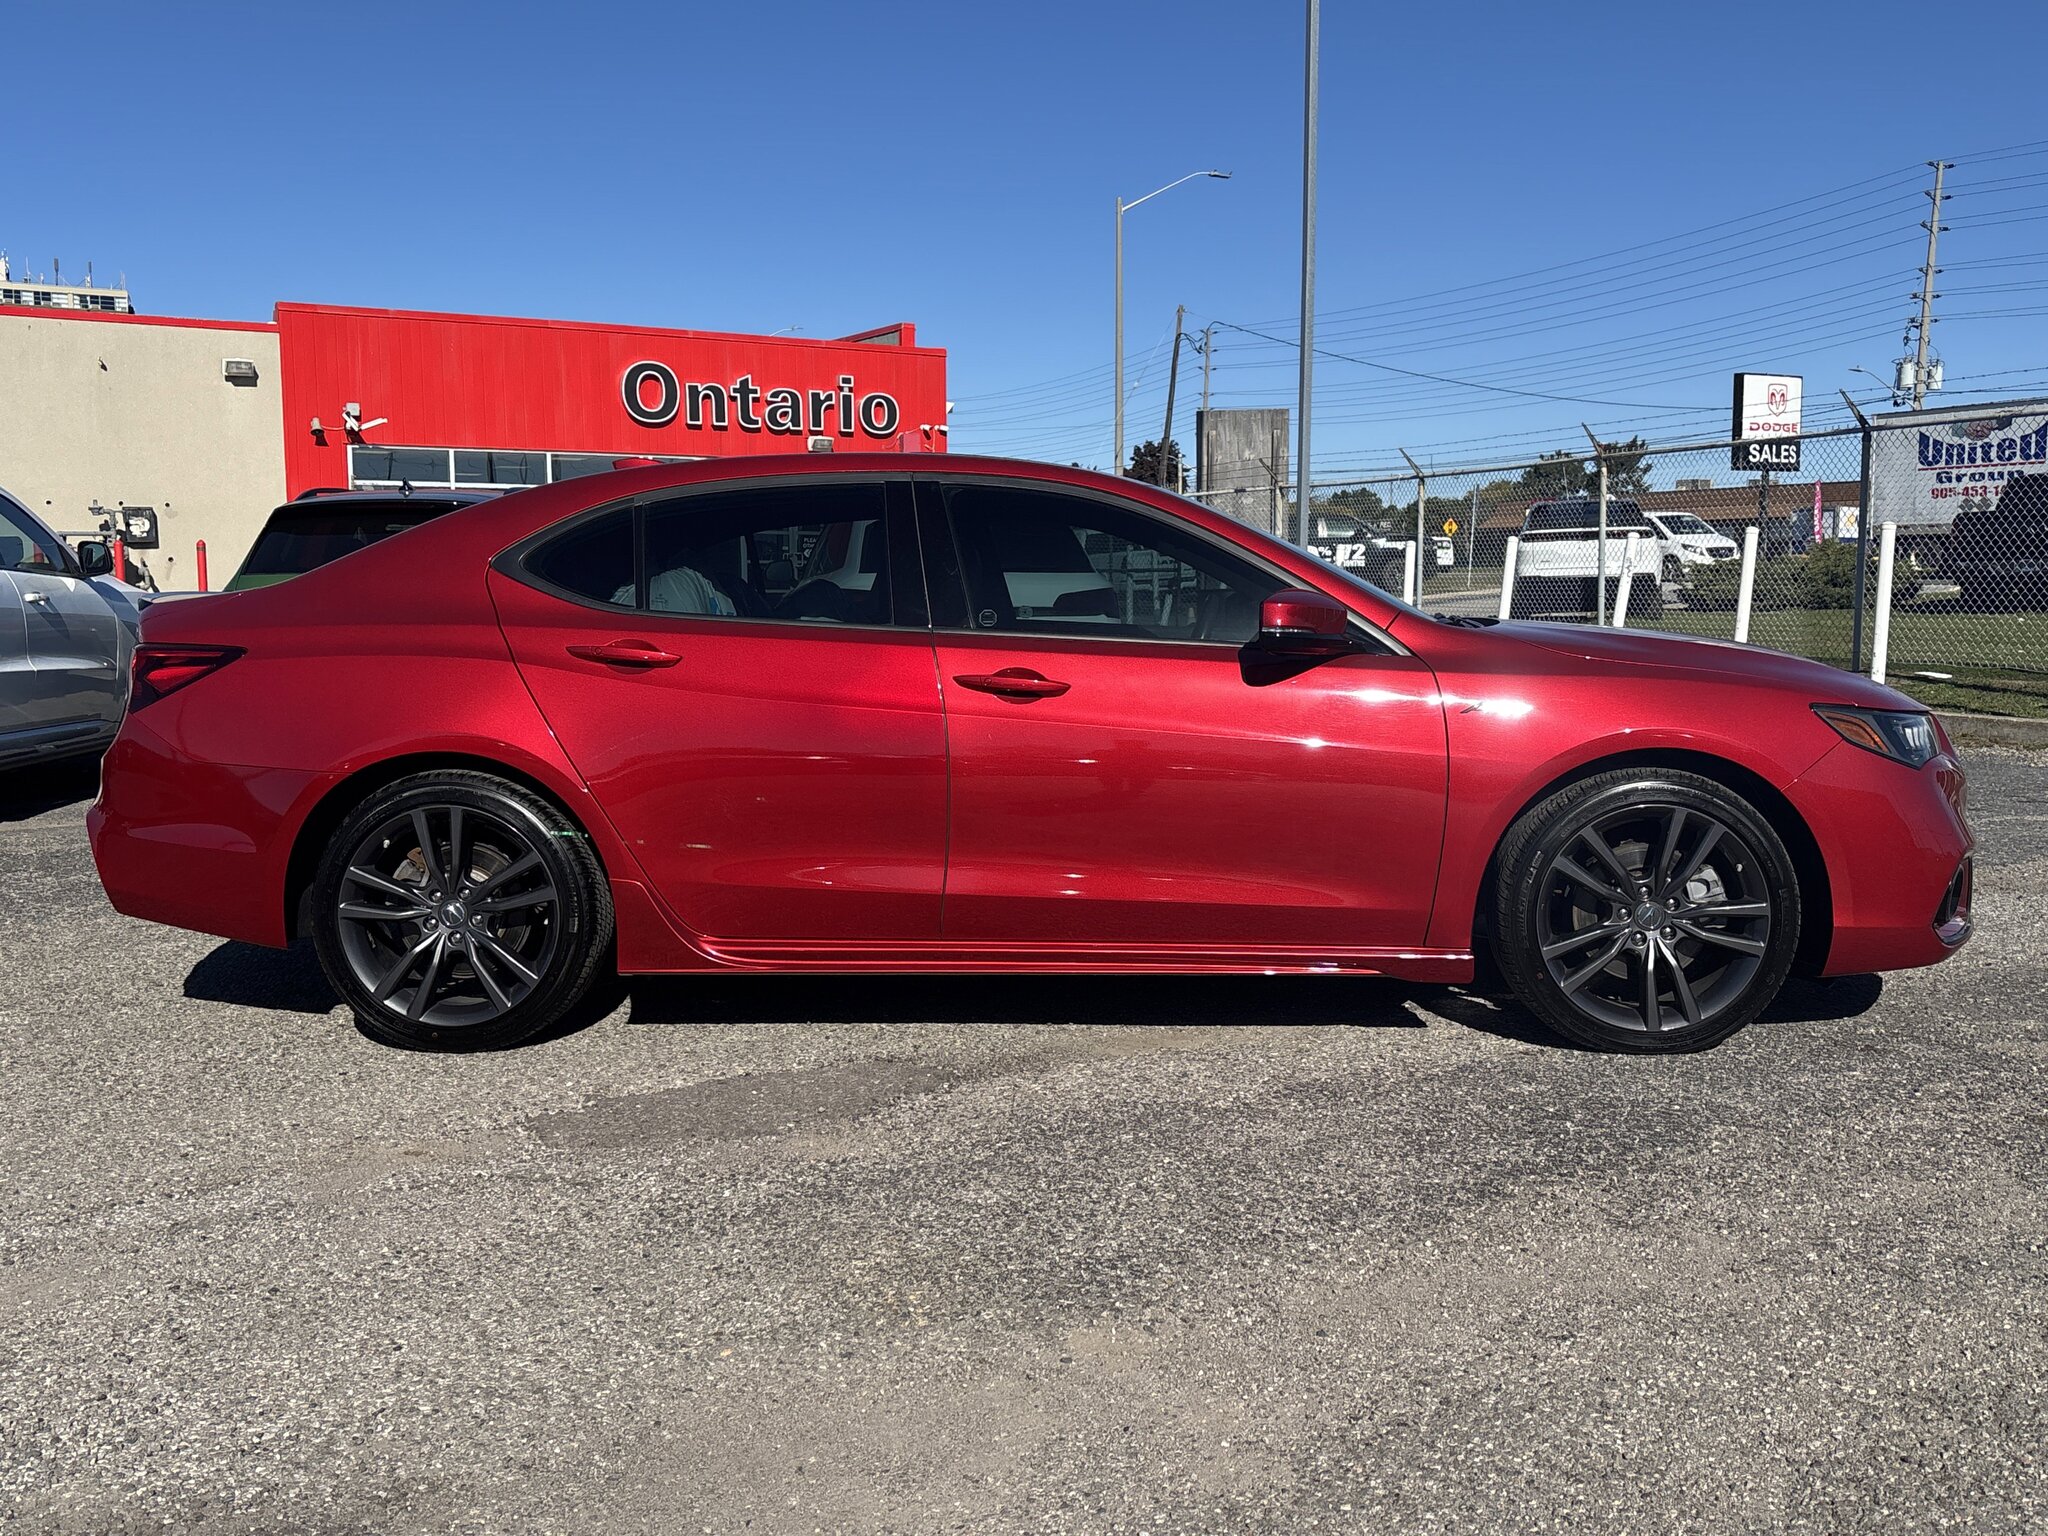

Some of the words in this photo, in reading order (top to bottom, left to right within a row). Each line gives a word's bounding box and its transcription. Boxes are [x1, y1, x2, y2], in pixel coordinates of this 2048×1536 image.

[622, 360, 900, 434] Ontario
[1749, 422, 1798, 433] DODGE
[1748, 443, 1797, 464] SALES
